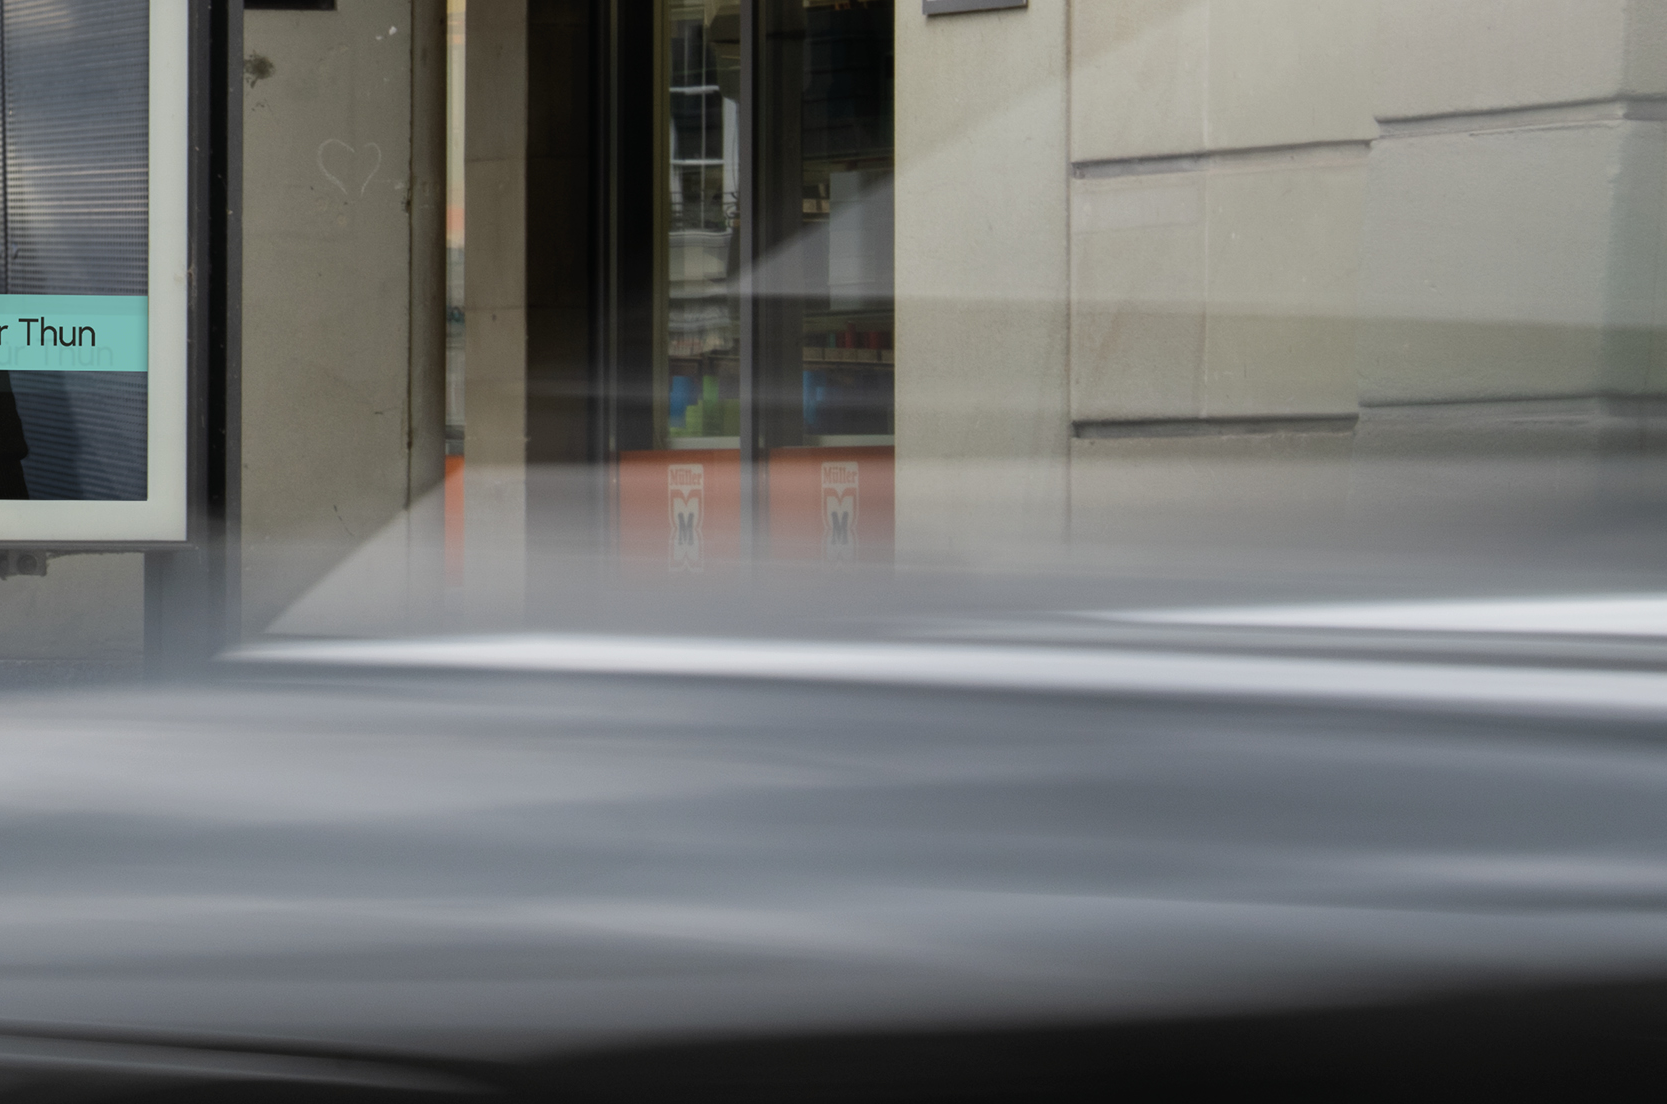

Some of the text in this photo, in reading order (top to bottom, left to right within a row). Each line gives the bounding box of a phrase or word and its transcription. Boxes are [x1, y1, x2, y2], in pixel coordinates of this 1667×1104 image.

[19, 317, 95, 346] Thun
[670, 469, 703, 486] Müller
[823, 467, 859, 484] Müller
[677, 512, 695, 546] M
[831, 511, 849, 545] M
